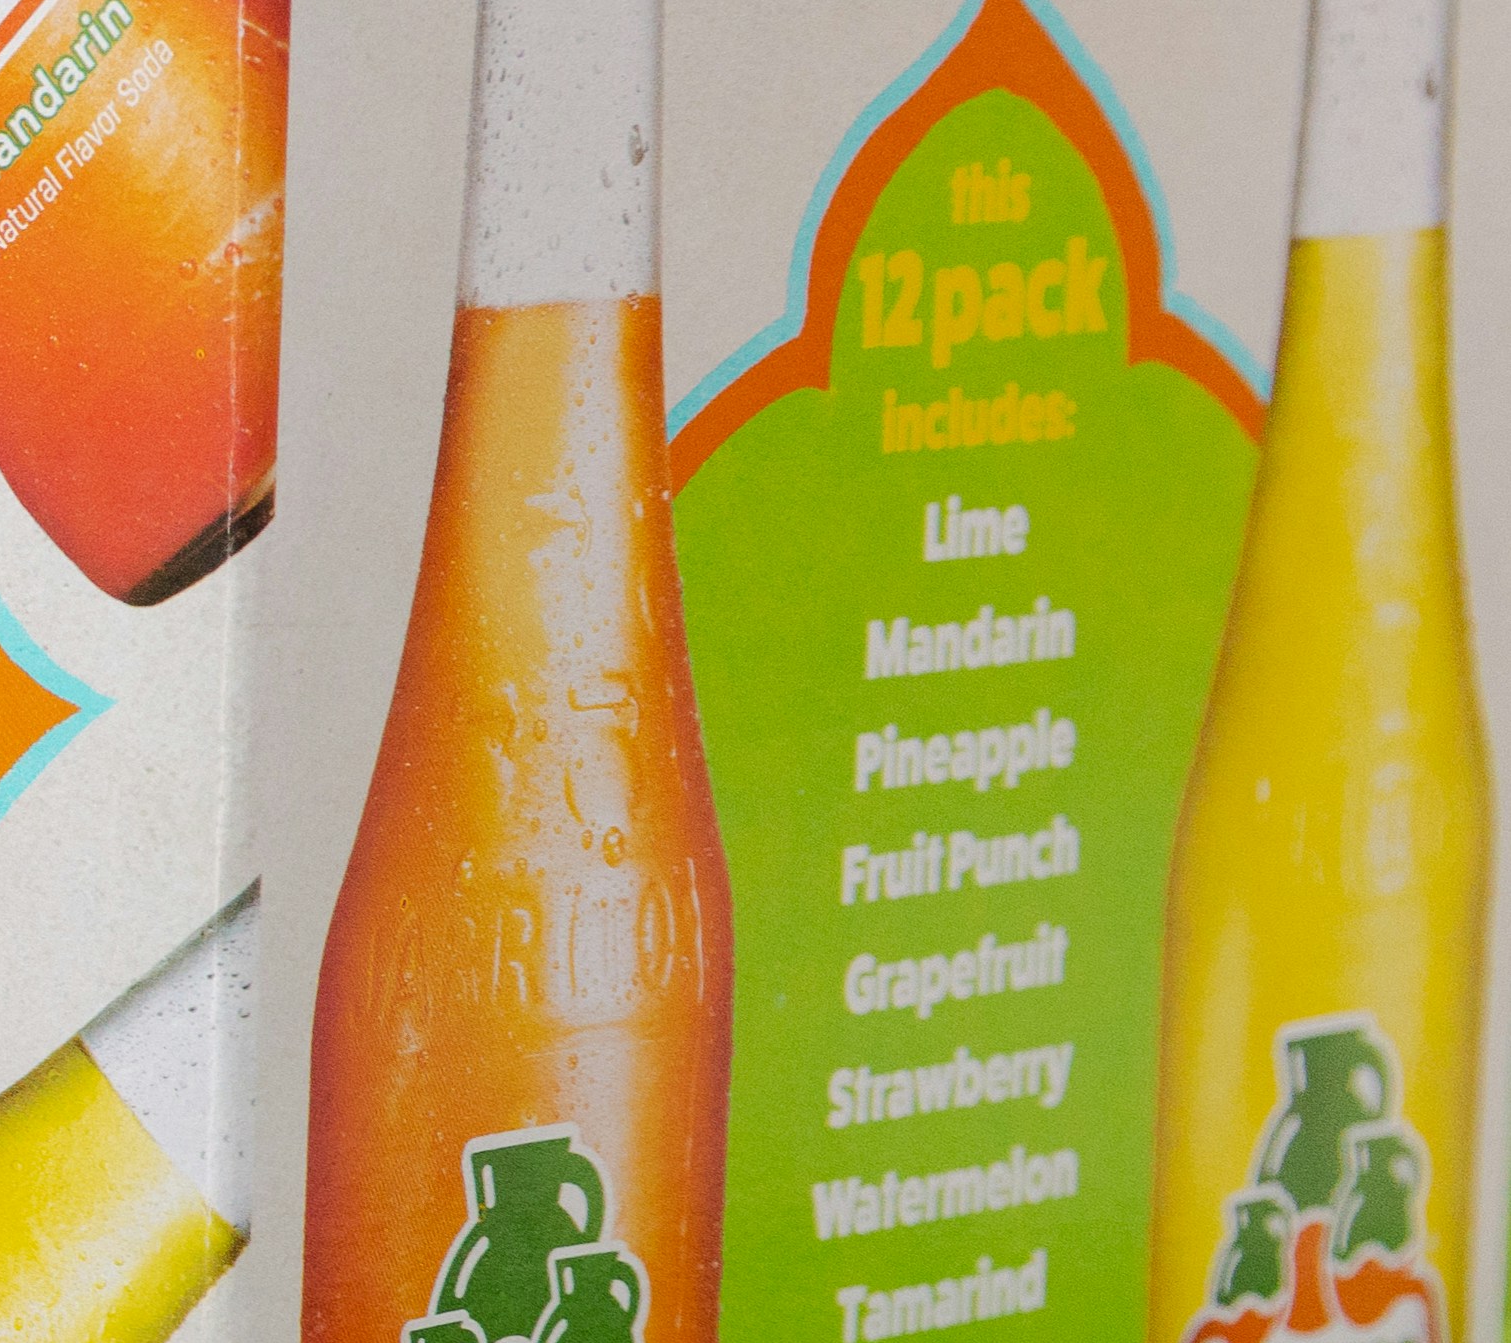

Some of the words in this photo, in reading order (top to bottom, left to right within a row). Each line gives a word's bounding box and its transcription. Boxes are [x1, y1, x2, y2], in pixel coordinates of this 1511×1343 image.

[55, 100, 121, 179] Flavor
[117, 39, 174, 106] Soda
[950, 157, 1030, 224] this
[857, 247, 925, 350] 12
[931, 236, 1107, 368] pack
[882, 382, 1075, 453] includes:
[922, 494, 1029, 562] Lime
[864, 597, 1077, 680] Mandarin
[854, 707, 1077, 794] Pineapple
[841, 832, 945, 906] Fruit
[949, 815, 1080, 890] Punch
[844, 922, 1068, 1018] Grapefruit
[827, 1036, 1074, 1128] Strawberry
[813, 1141, 1078, 1240] Watermelon
